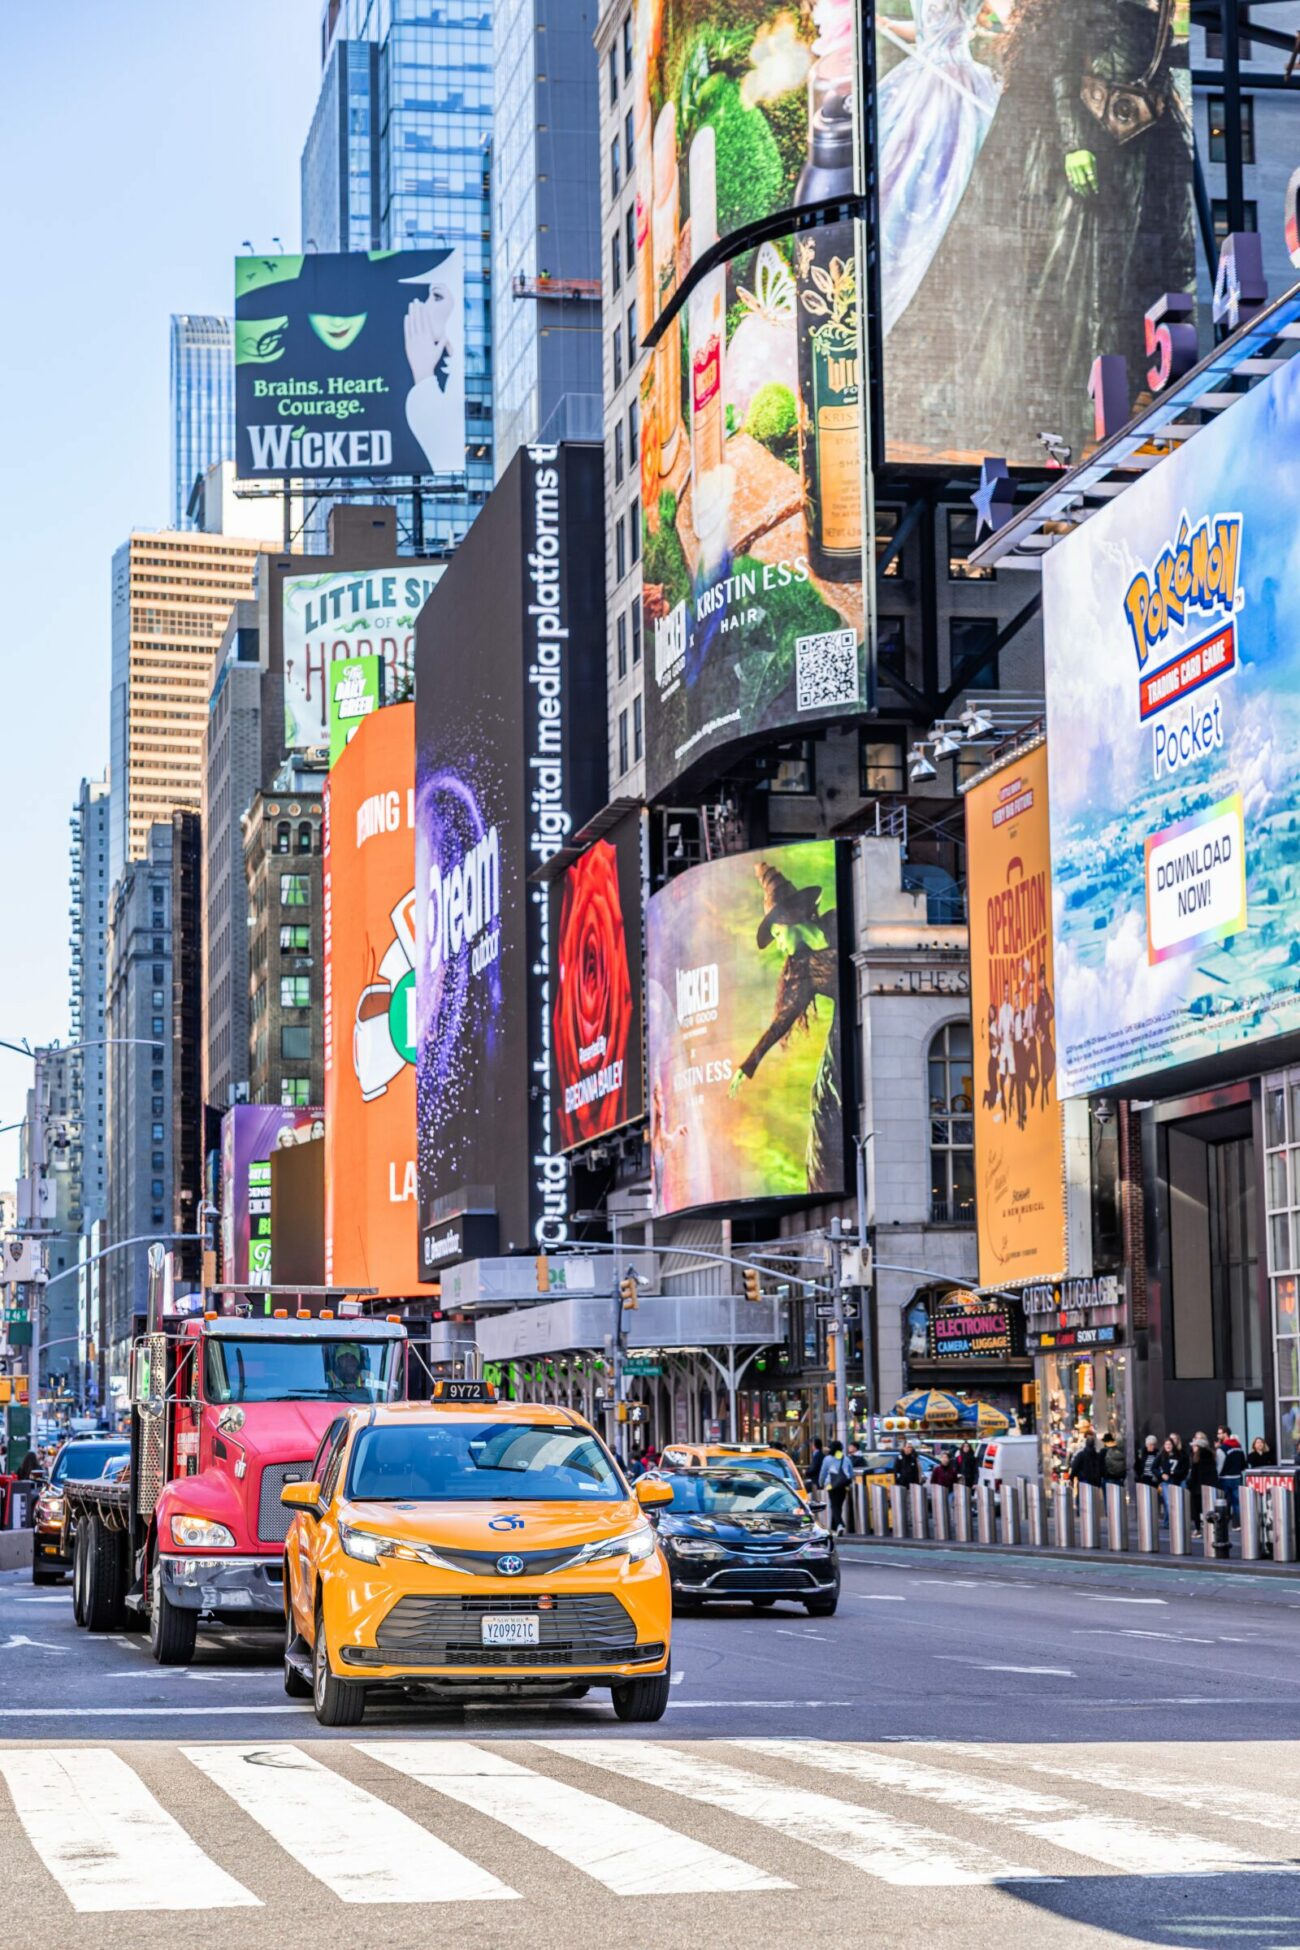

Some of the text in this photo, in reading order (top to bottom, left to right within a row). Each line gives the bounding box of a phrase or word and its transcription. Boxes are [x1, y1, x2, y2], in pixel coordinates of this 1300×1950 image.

[253, 376, 390, 397] Brains. Heart.
[277, 398, 366, 420] Courage.
[527, 467, 570, 639] platforms
[305, 576, 397, 635] LITTLE
[697, 555, 809, 623] KRISTIN ESS
[374, 617, 393, 629] OF
[720, 607, 758, 634] HAIR
[1147, 639, 1226, 706] TRADING CARD GAME
[528, 641, 562, 754] media
[1155, 700, 1221, 775] Pocket
[530, 756, 572, 867] digital
[1157, 834, 1232, 893] DOWNLOAD
[987, 871, 1047, 956] OPERATION
[1178, 879, 1212, 918] NOW!
[903, 970, 948, 990] THE
[597, 1059, 624, 1098] BAILEY
[705, 1058, 733, 1083] ESS
[1023, 1275, 1119, 1315] GIFTS LUGGAGE
[935, 1314, 1006, 1338] ELECTRONICS
[1077, 1329, 1097, 1343] SONY
[937, 1335, 1008, 1353] CAMERA LUGGAGE
[450, 1384, 481, 1398] 9Y72
[1169, 1459, 1179, 1475] 7
[487, 1623, 534, 1638] Y209921C
